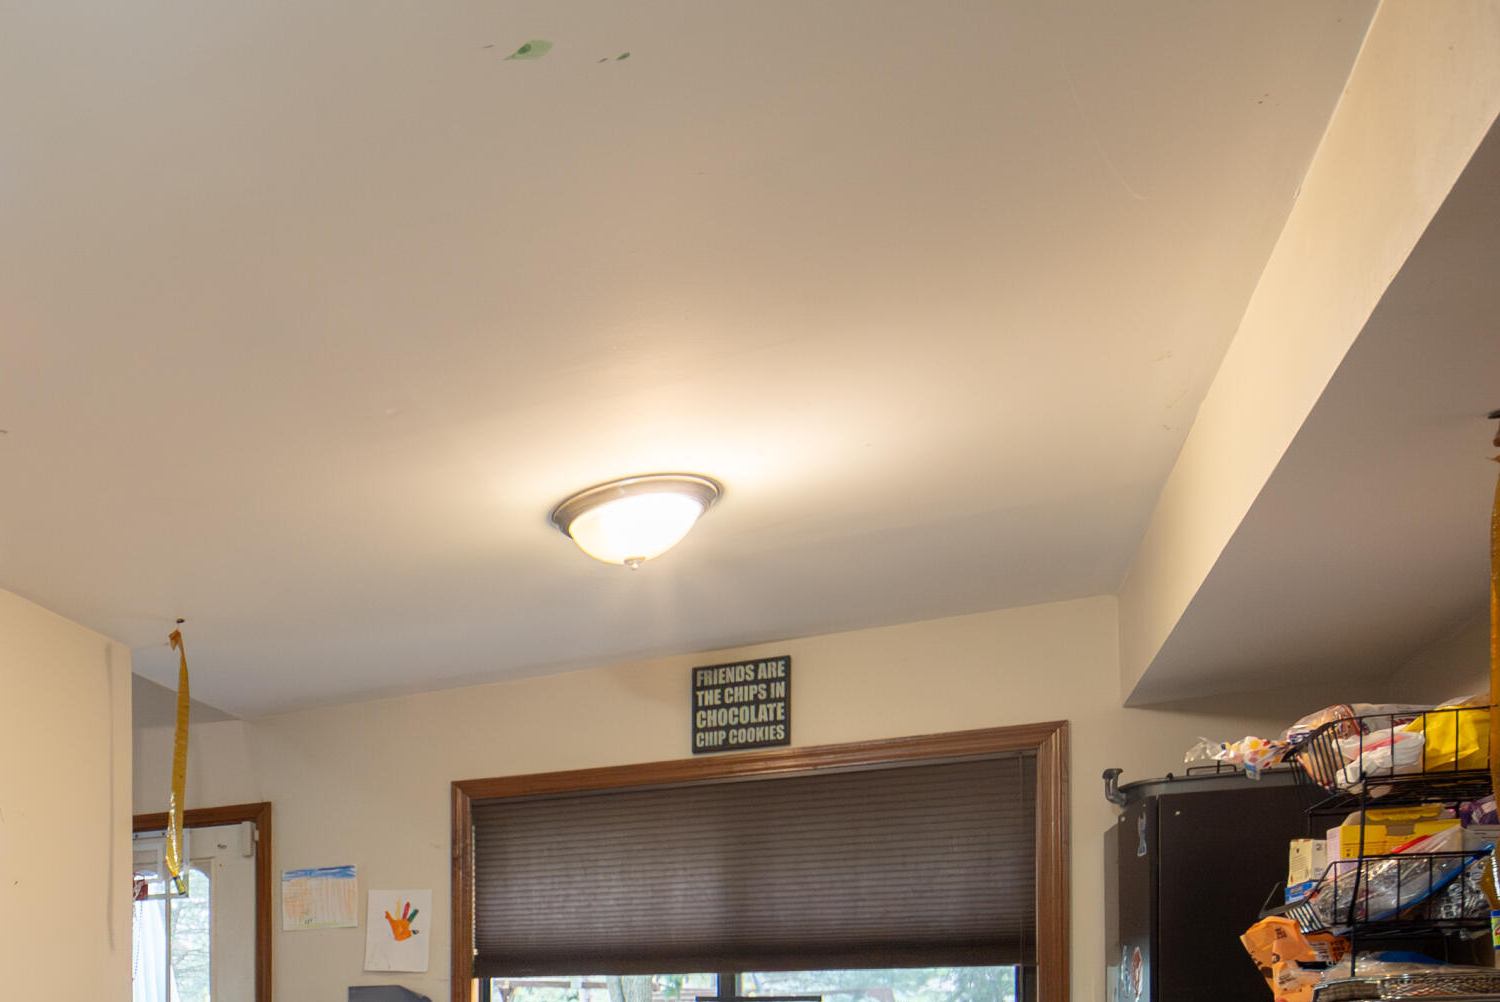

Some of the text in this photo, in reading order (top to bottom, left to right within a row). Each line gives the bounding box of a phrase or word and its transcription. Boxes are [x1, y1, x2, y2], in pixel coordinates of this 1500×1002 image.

[696, 660, 786, 687] FRIENDS ARE
[695, 681, 786, 707] THE CHIPS IN
[695, 701, 786, 729] CHOCOLATE
[695, 724, 786, 748] CHIP COOKIES
